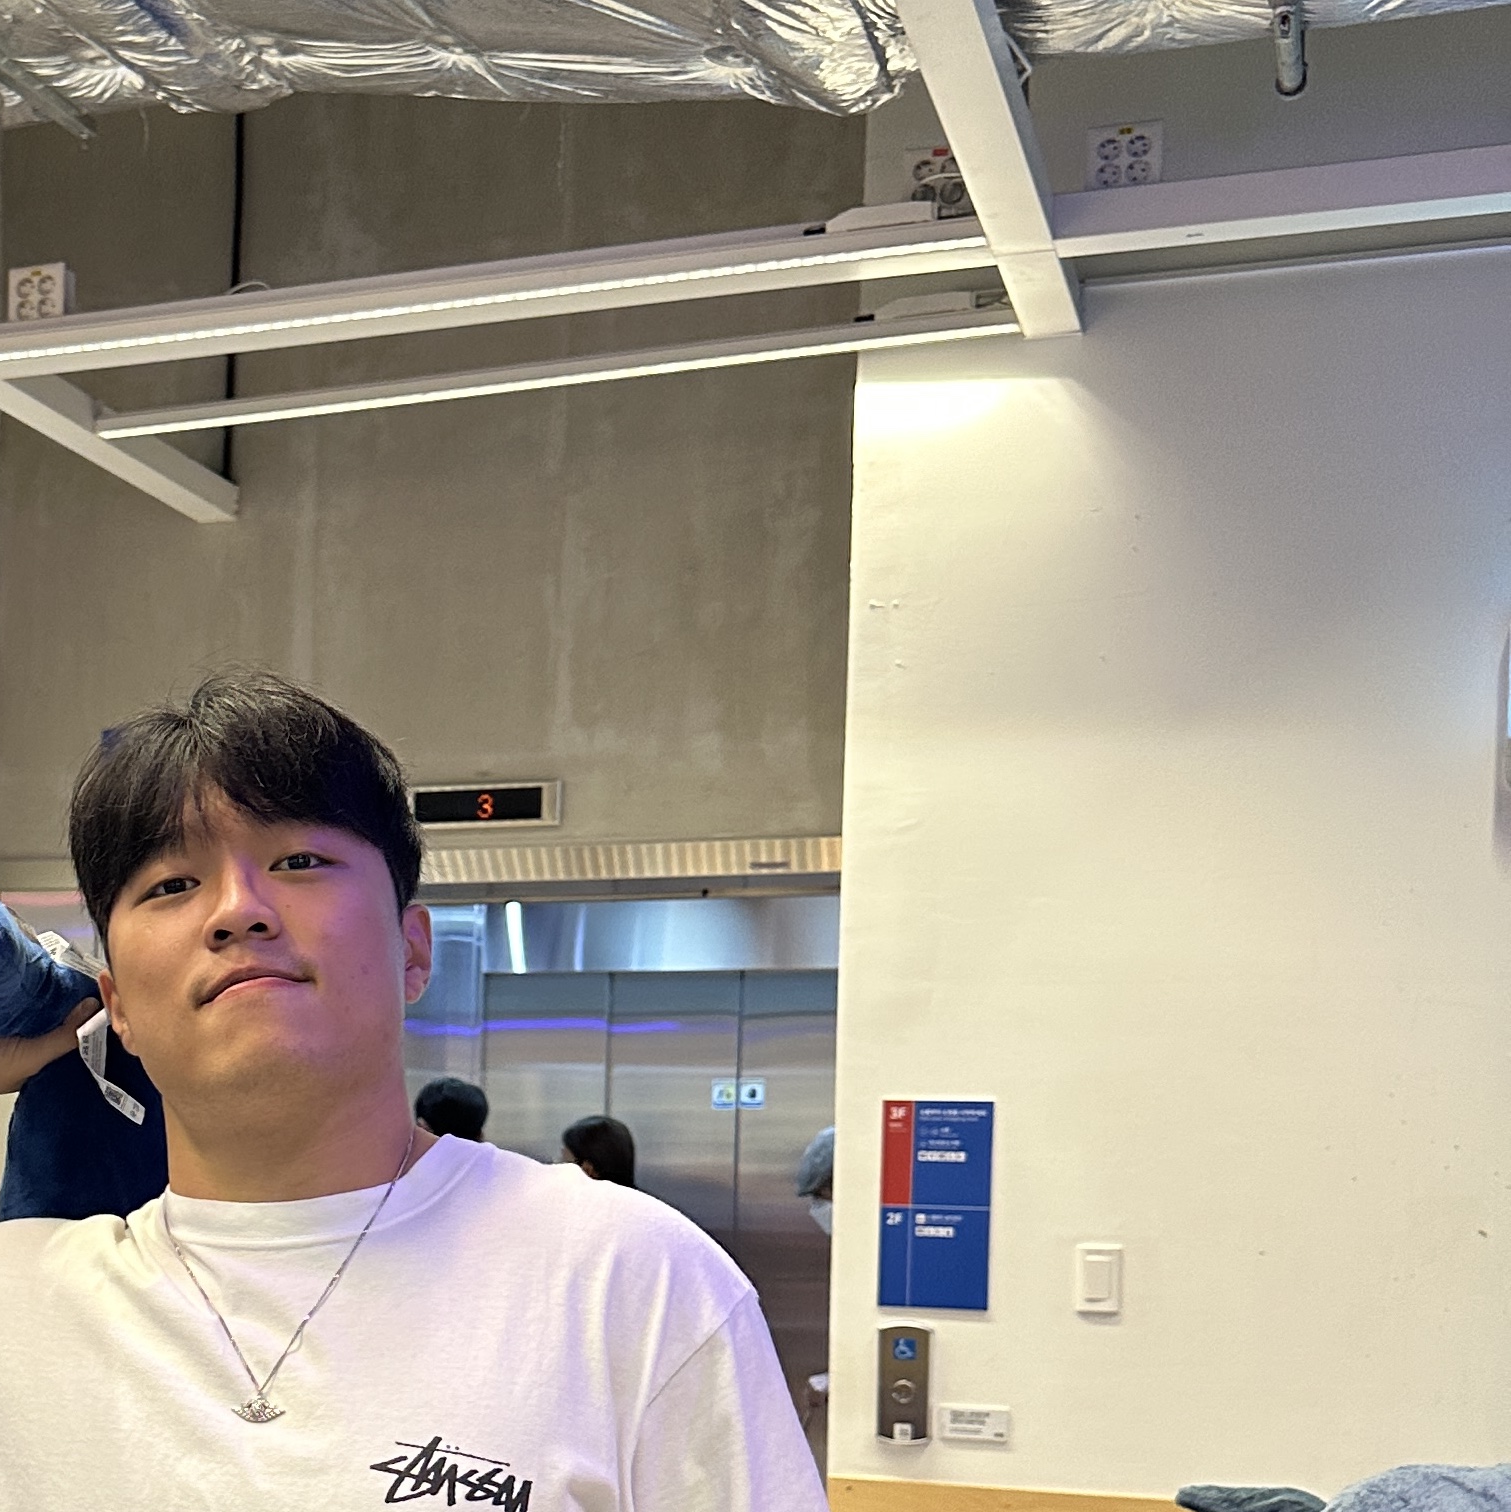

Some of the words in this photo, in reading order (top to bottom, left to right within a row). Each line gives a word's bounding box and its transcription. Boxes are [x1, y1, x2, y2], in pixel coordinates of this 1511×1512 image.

[476, 793, 494, 819] 3
[889, 1106, 907, 1120] 3F
[886, 1211, 904, 1226] 2F
